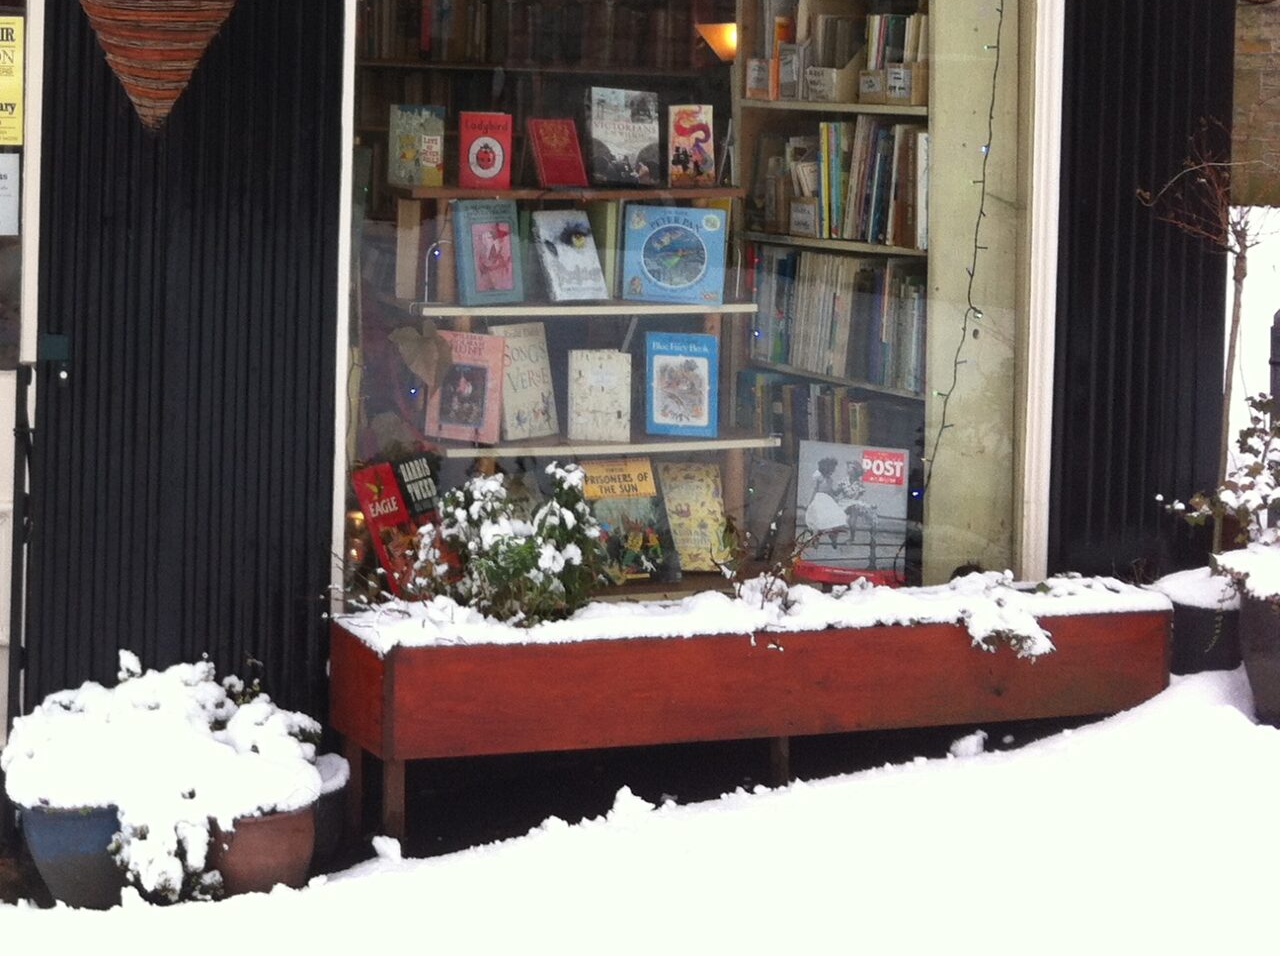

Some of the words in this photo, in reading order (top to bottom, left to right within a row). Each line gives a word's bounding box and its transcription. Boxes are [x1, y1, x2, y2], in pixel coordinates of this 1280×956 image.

[465, 120, 508, 134] Ladybird
[593, 121, 656, 133] VICTORIANS
[503, 342, 547, 367] SONGS
[506, 367, 550, 393] VERSE
[400, 457, 431, 483] HARRIS
[862, 458, 904, 477] POST
[585, 473, 633, 485] PRISONERS
[636, 472, 649, 483] OF
[406, 477, 438, 502] TWEED
[600, 485, 617, 494] THE
[619, 484, 638, 493] SUN
[368, 496, 399, 517] EAGLE
